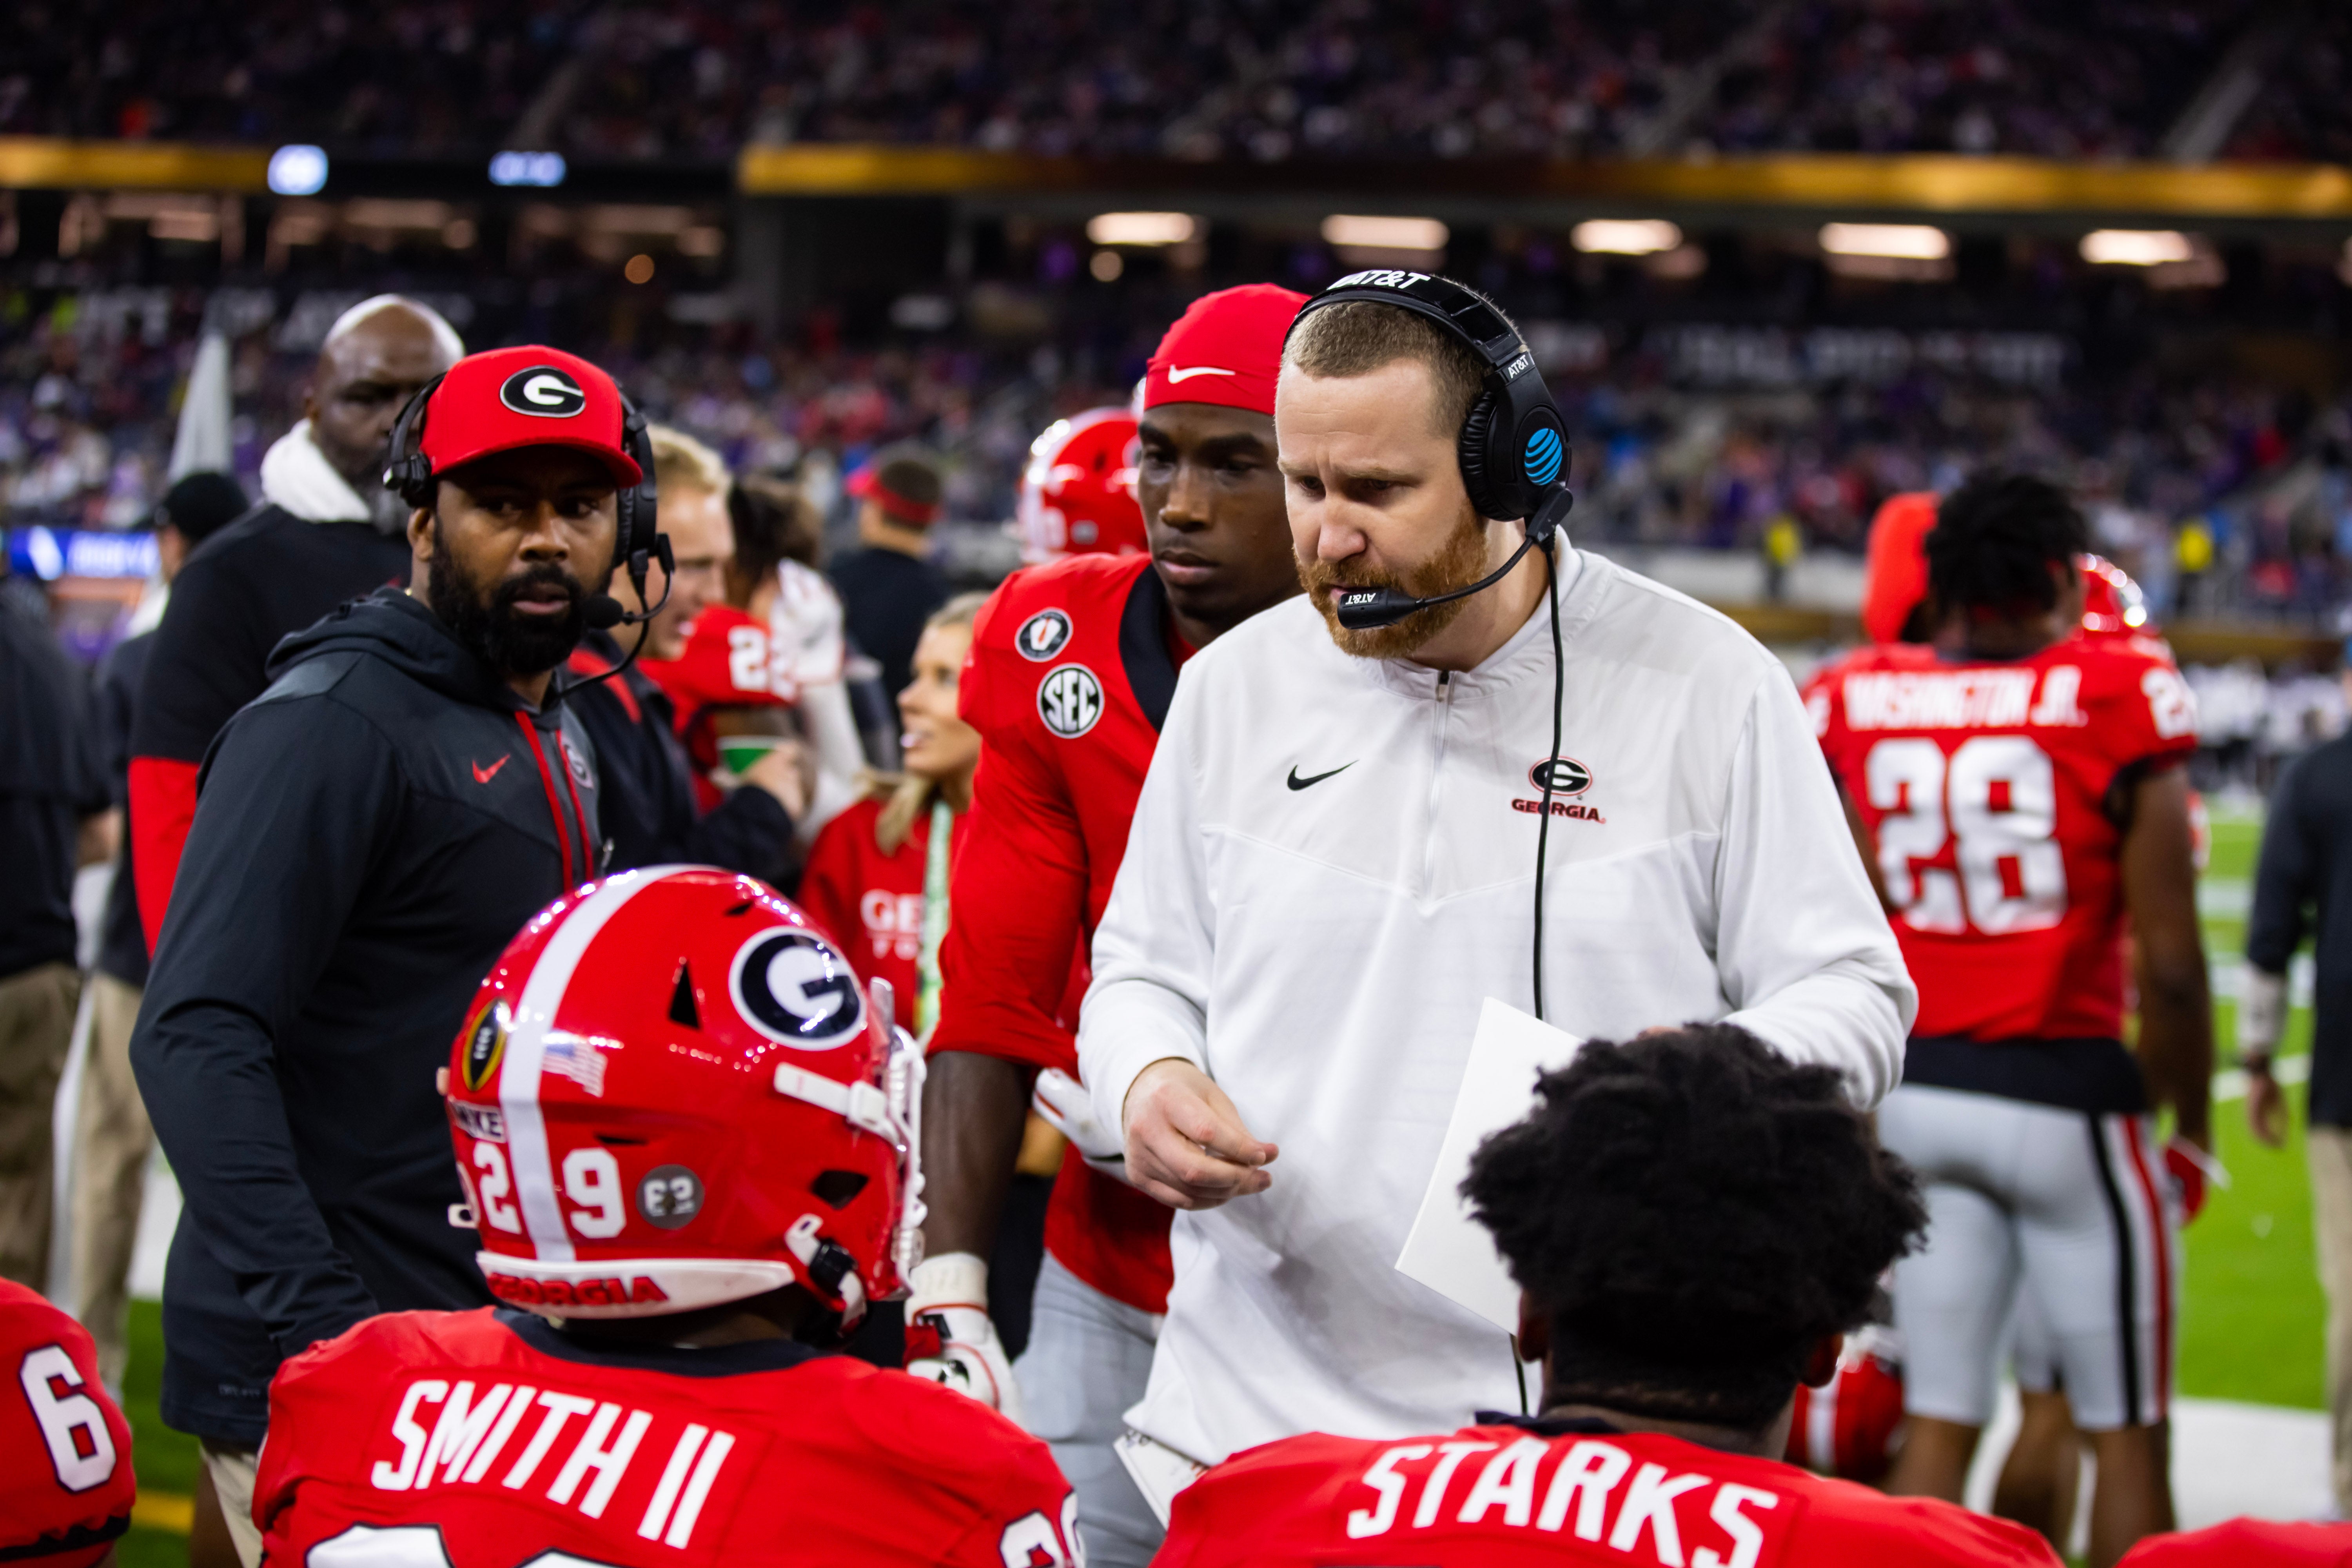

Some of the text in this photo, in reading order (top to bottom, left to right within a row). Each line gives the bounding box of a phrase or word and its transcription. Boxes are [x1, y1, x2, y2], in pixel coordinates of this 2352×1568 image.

[1334, 269, 1431, 289] AT&T
[1508, 354, 1529, 379] AT&T
[1345, 593, 1376, 605] AT&T
[1043, 669, 1098, 733] SEC
[1512, 798, 1601, 822] GERGIA
[1866, 735, 2069, 935] 28
[20, 1343, 117, 1494] 6
[371, 1379, 735, 1550] SMITH II
[1346, 1436, 1780, 1568] STARKS
